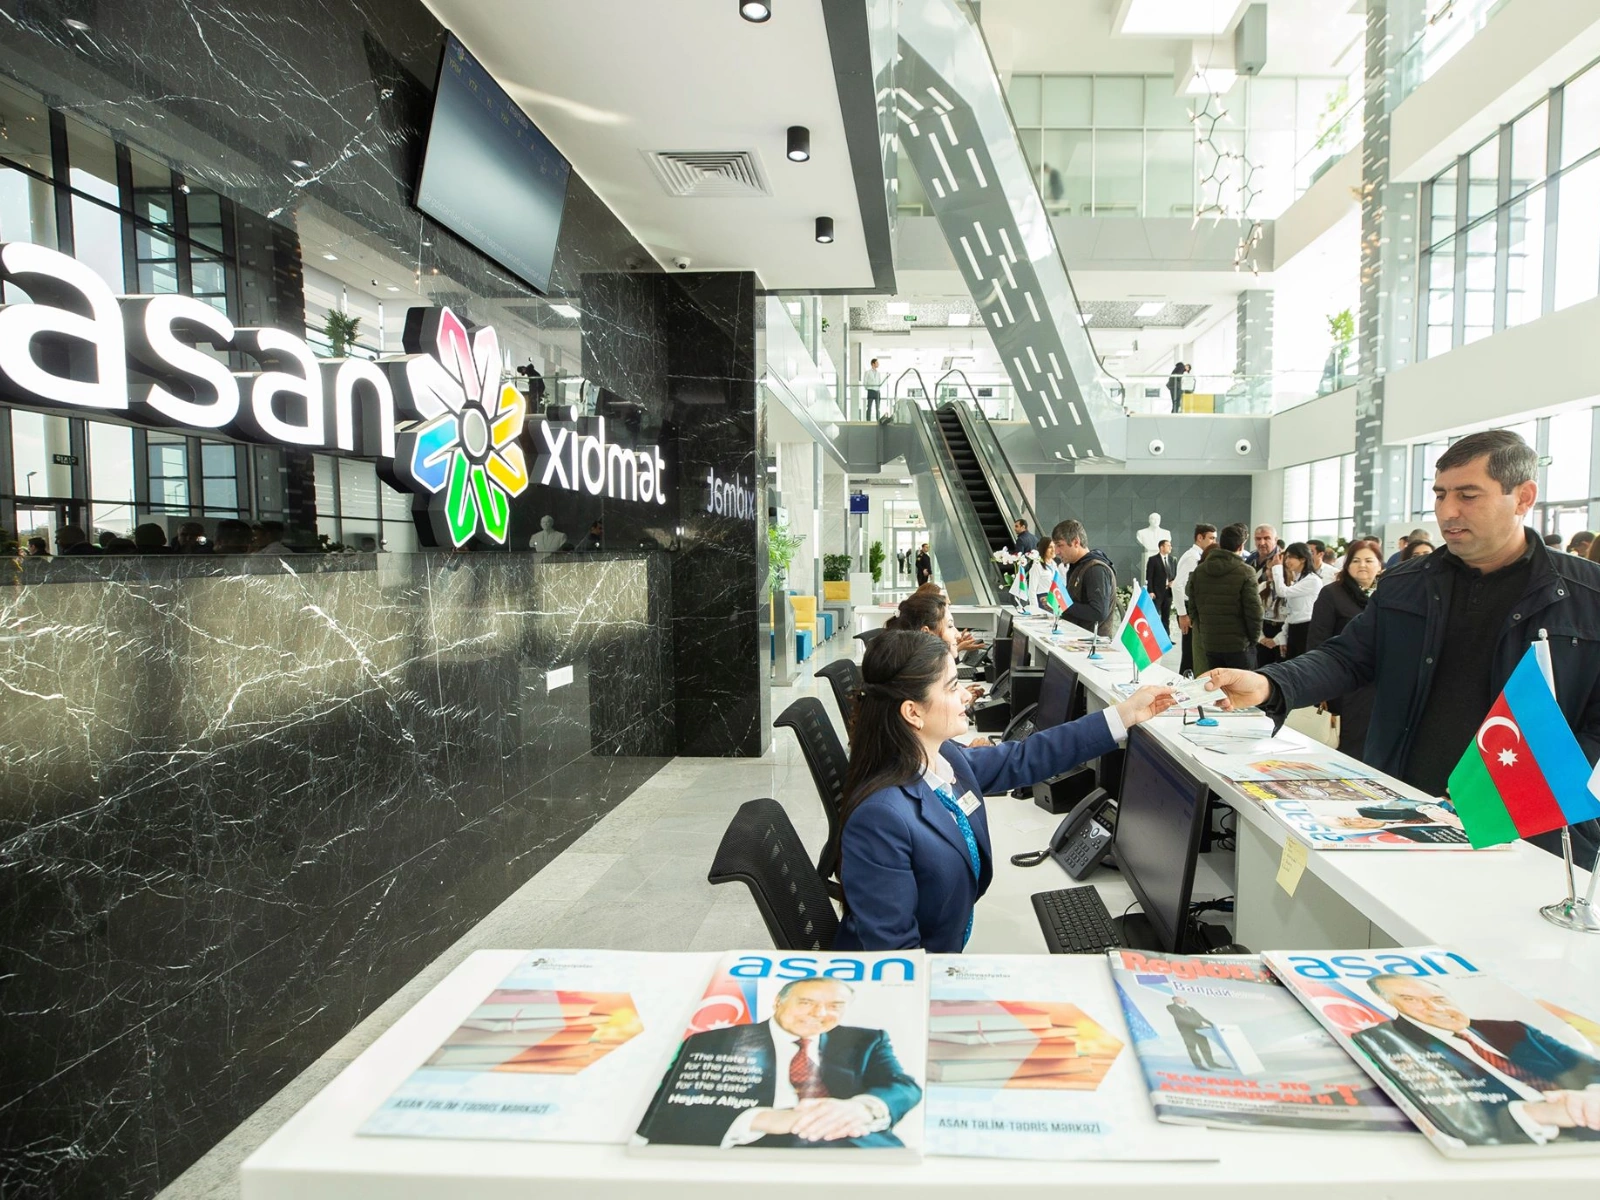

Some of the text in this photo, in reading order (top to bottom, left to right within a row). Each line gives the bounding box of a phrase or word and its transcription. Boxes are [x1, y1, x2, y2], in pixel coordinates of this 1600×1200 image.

[0, 242, 396, 458] asan
[729, 956, 914, 981] asan
[1120, 951, 1257, 981] Region
[1287, 951, 1480, 979] asan
[715, 1054, 746, 1064] state
[684, 1062, 700, 1071] for
[702, 1062, 722, 1072] the
[679, 1072, 763, 1085] not the people
[675, 1081, 693, 1090] for
[694, 1081, 715, 1091] the
[668, 1094, 759, 1109] Heydar Aliyev
[938, 1118, 968, 1129] ASAN
